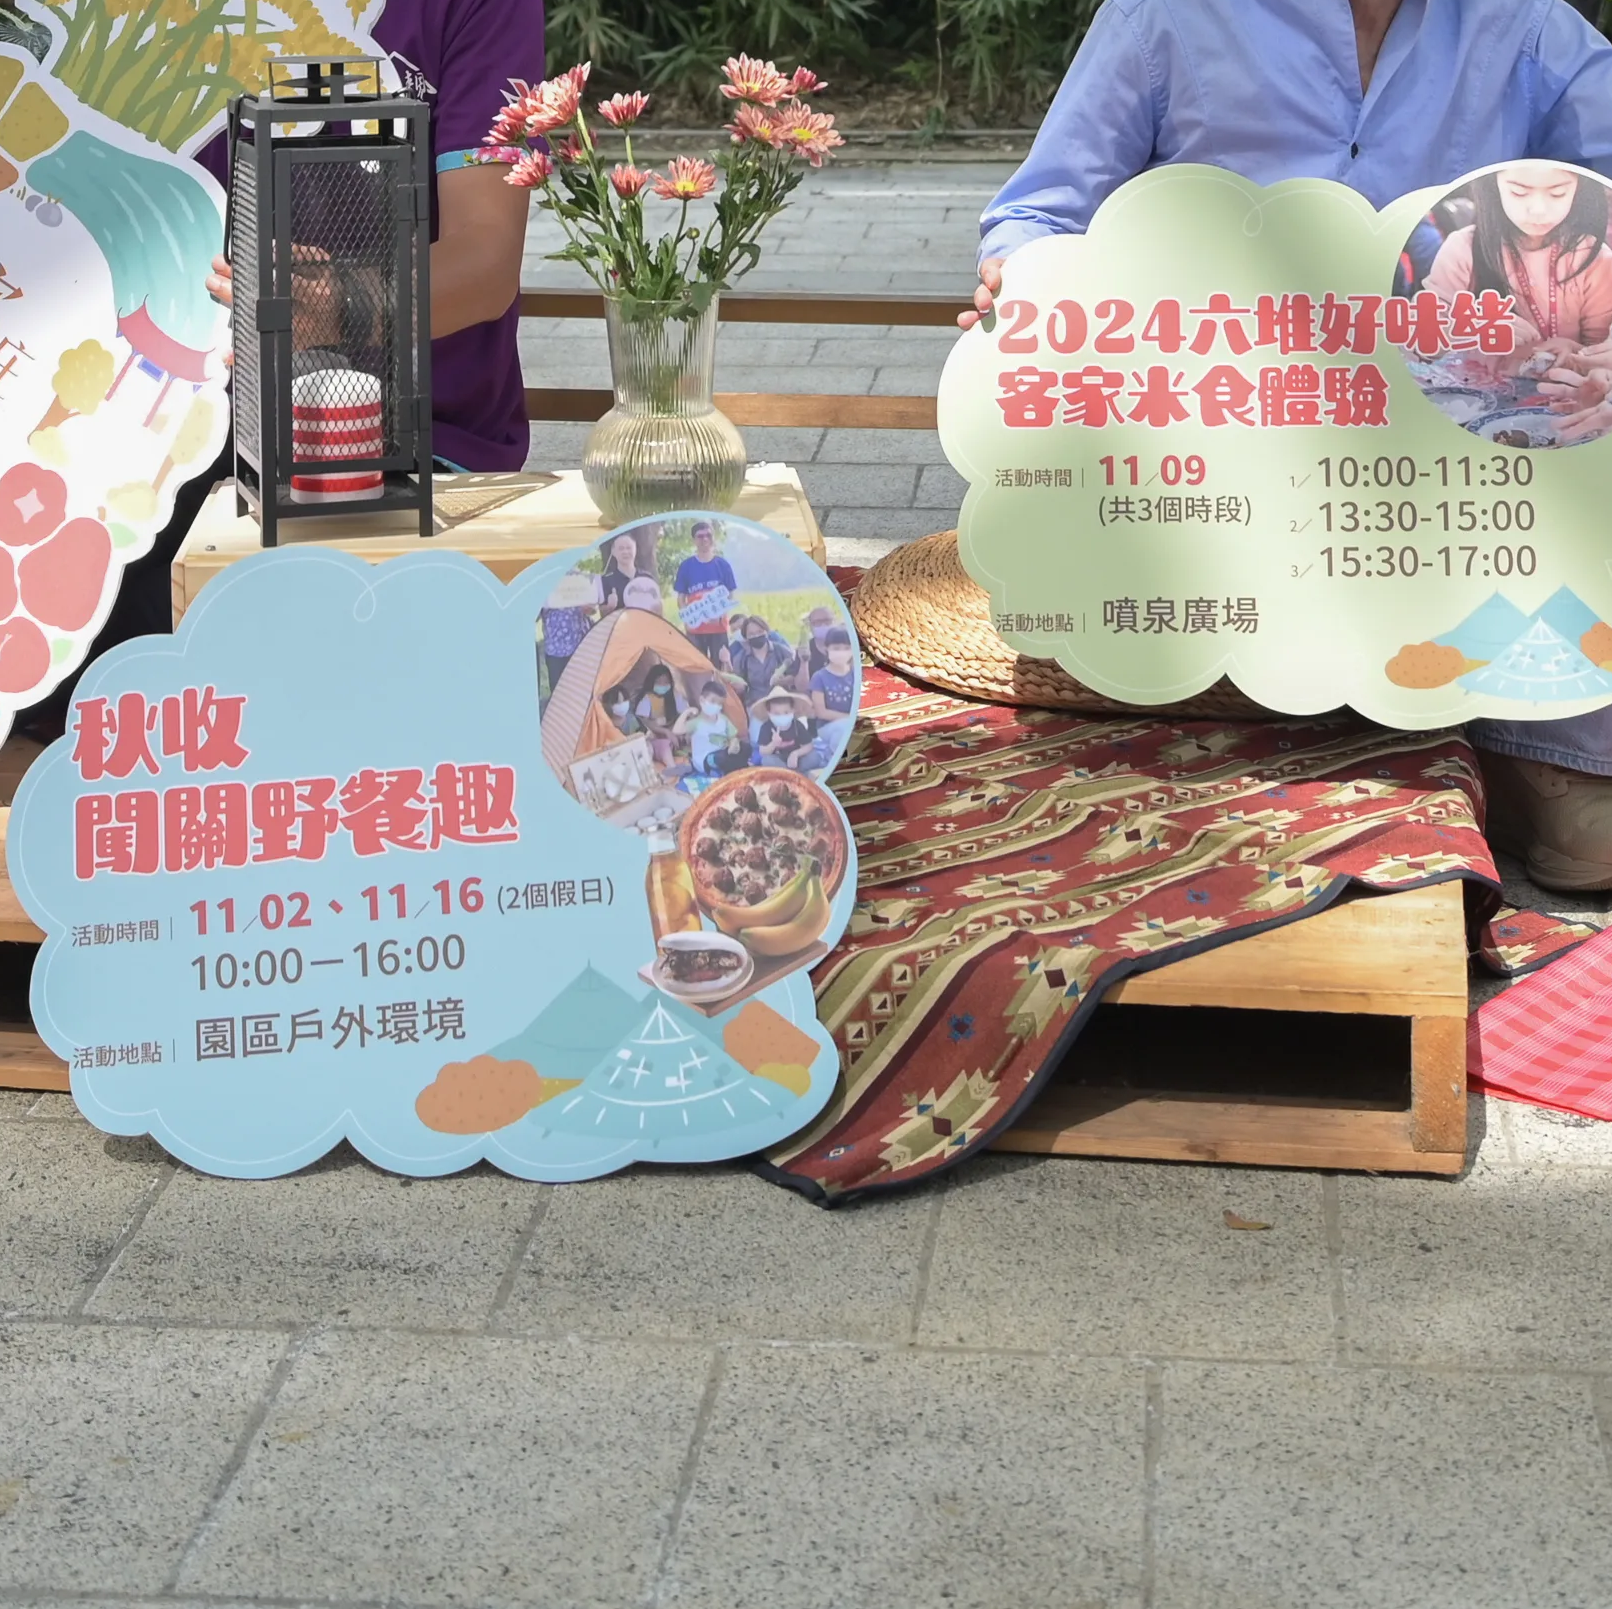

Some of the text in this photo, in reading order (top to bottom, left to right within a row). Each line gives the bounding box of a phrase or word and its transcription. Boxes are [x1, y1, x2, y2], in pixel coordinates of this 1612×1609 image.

[996, 363, 1389, 428] 客家米食體驗
[994, 454, 1207, 488] 活動時間 11/09
[1317, 455, 1534, 488] 10:00-11:30
[1098, 495, 1252, 526] (共3個時段)
[1318, 499, 1535, 533] 13:30-15:00
[1319, 544, 1537, 578] 15:30-17:00
[995, 596, 1260, 635] 活動地點 噴泉廣場
[72, 686, 249, 782] 秋收
[74, 763, 519, 879] 闖關野餐趣
[71, 919, 160, 948] 活動時間
[497, 876, 615, 916] (2個假日)
[72, 996, 467, 1070] 活動地點 園區戶外環境
